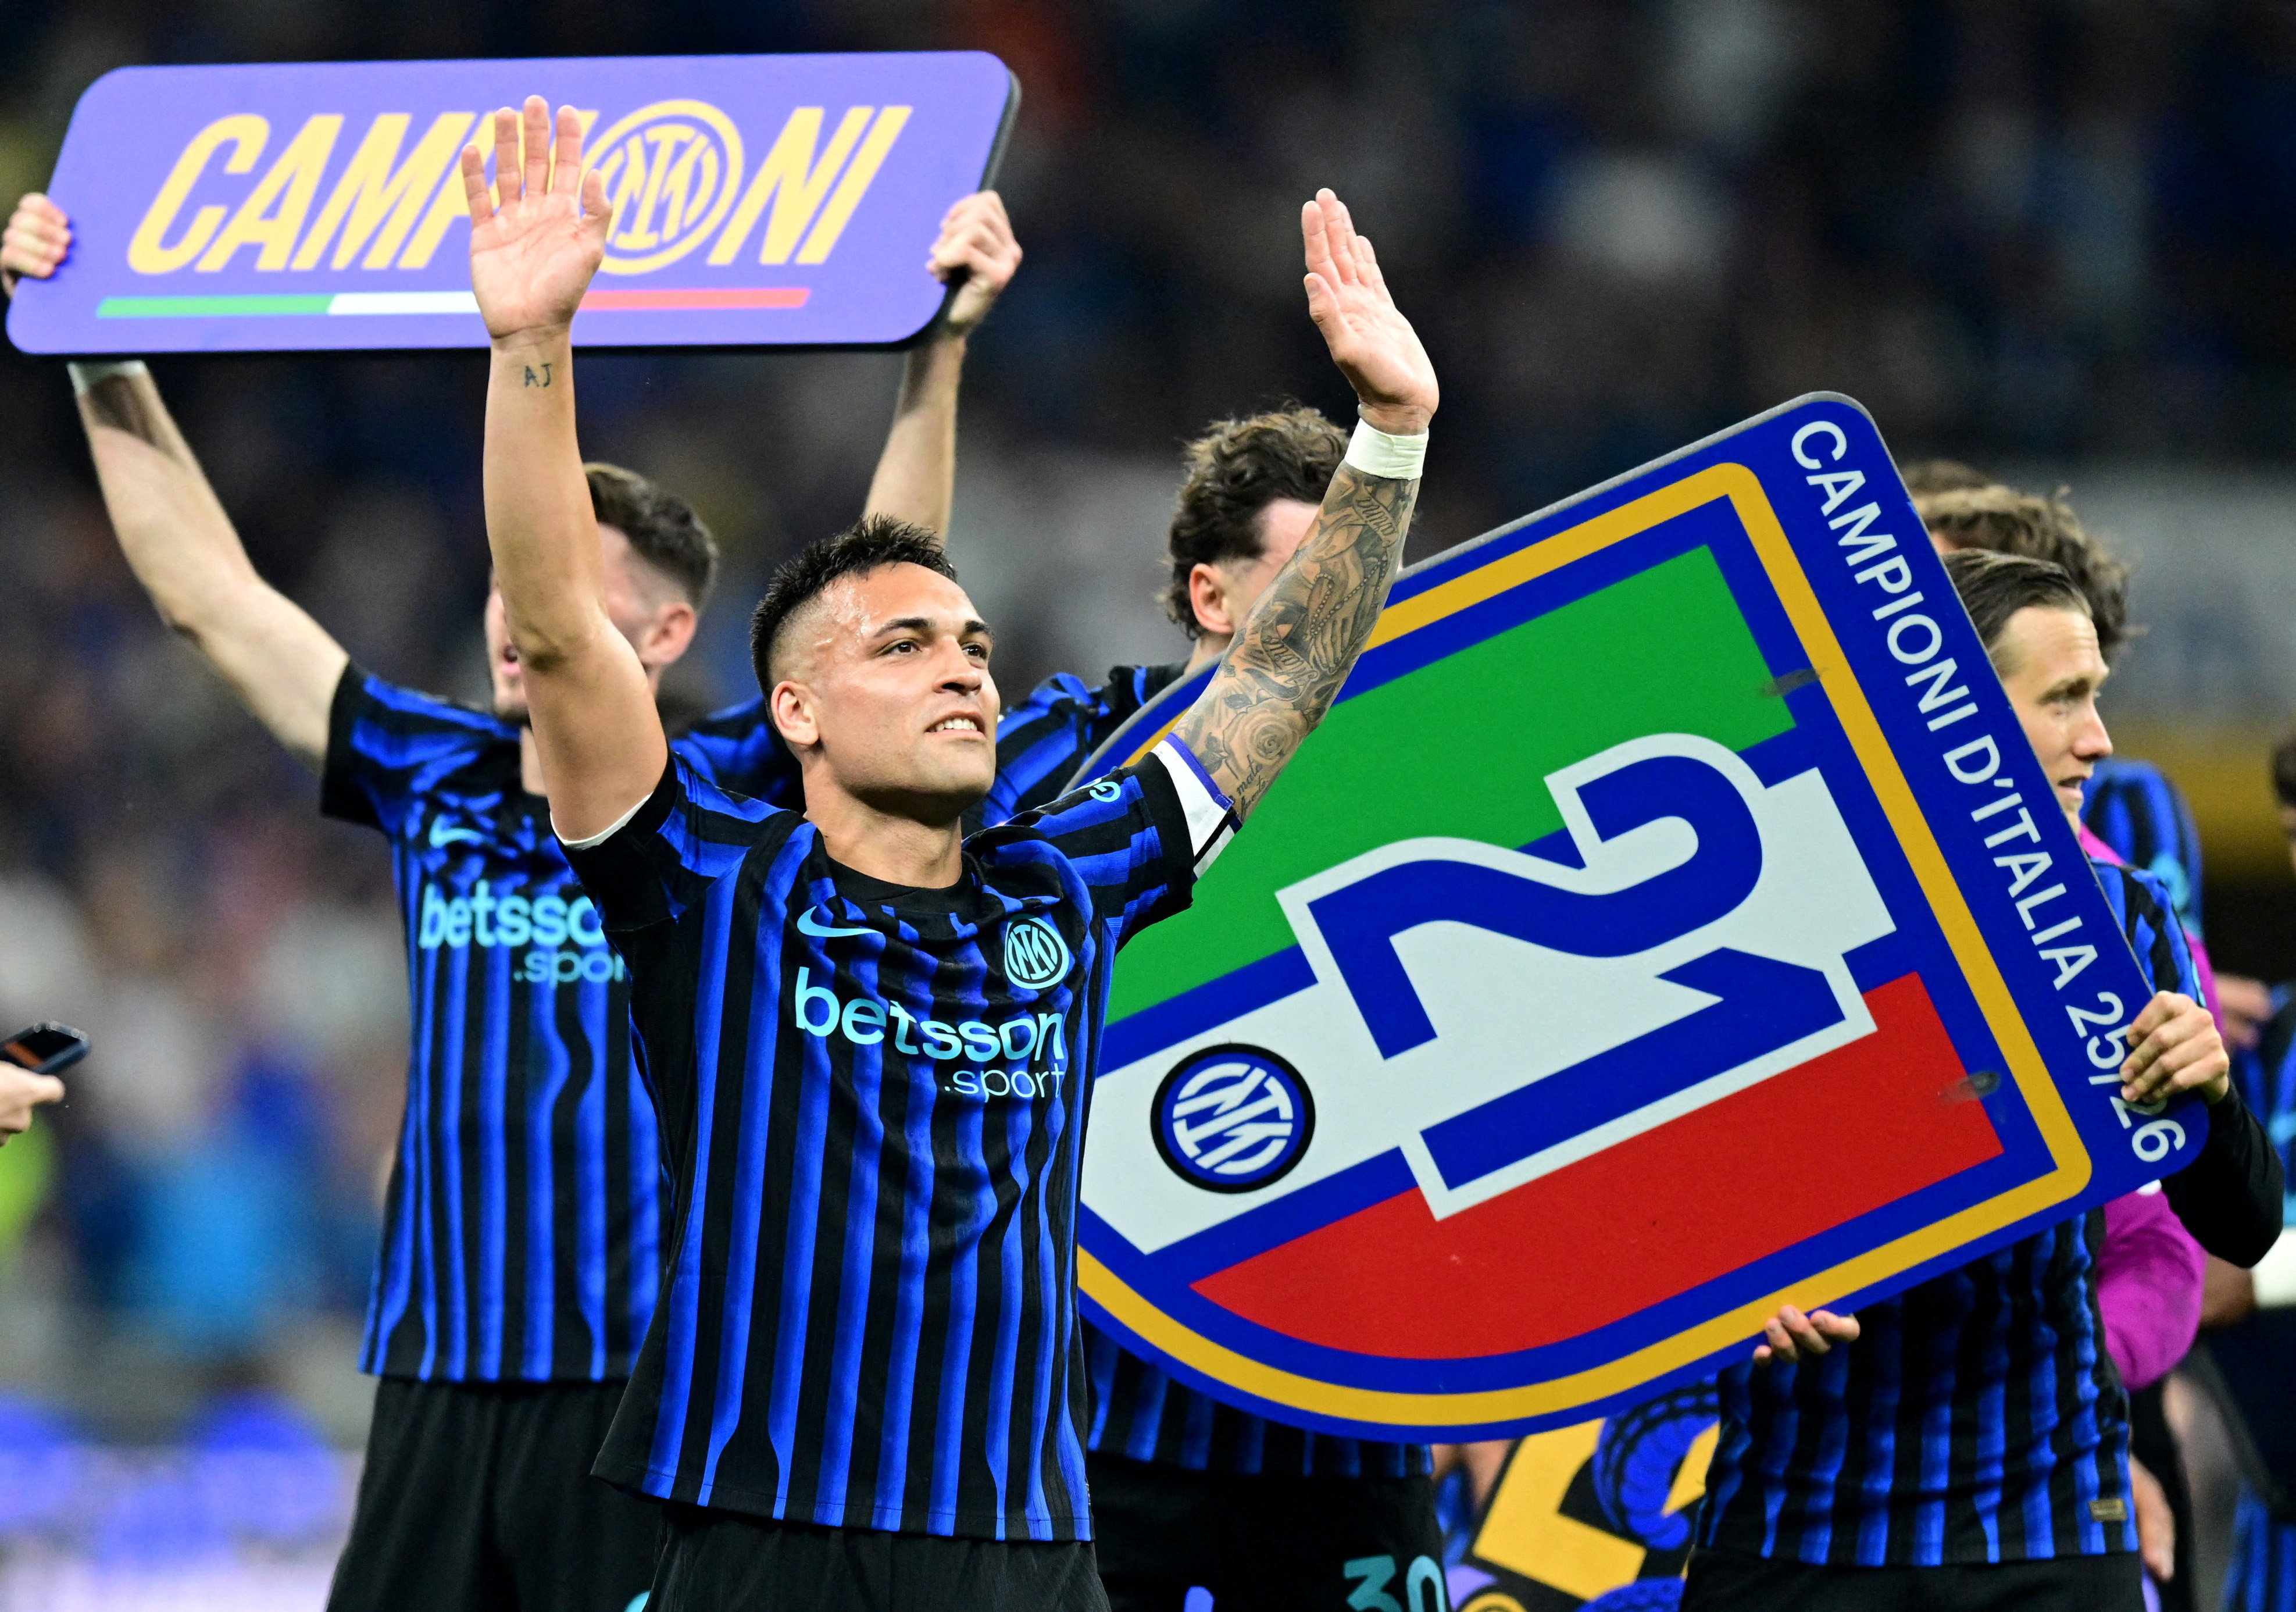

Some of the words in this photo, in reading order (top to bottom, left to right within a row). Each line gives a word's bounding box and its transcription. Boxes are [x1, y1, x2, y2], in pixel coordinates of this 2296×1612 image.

[525, 363, 552, 388] AJ
[1791, 421, 1979, 732] CAMPIONI
[1943, 734, 2098, 990] D'ITALIA
[419, 879, 607, 949] betsso
[513, 951, 624, 989] .spor
[1308, 756, 1845, 1190] 21
[795, 967, 1065, 1062] betsson
[945, 1063, 1064, 1103] .sport
